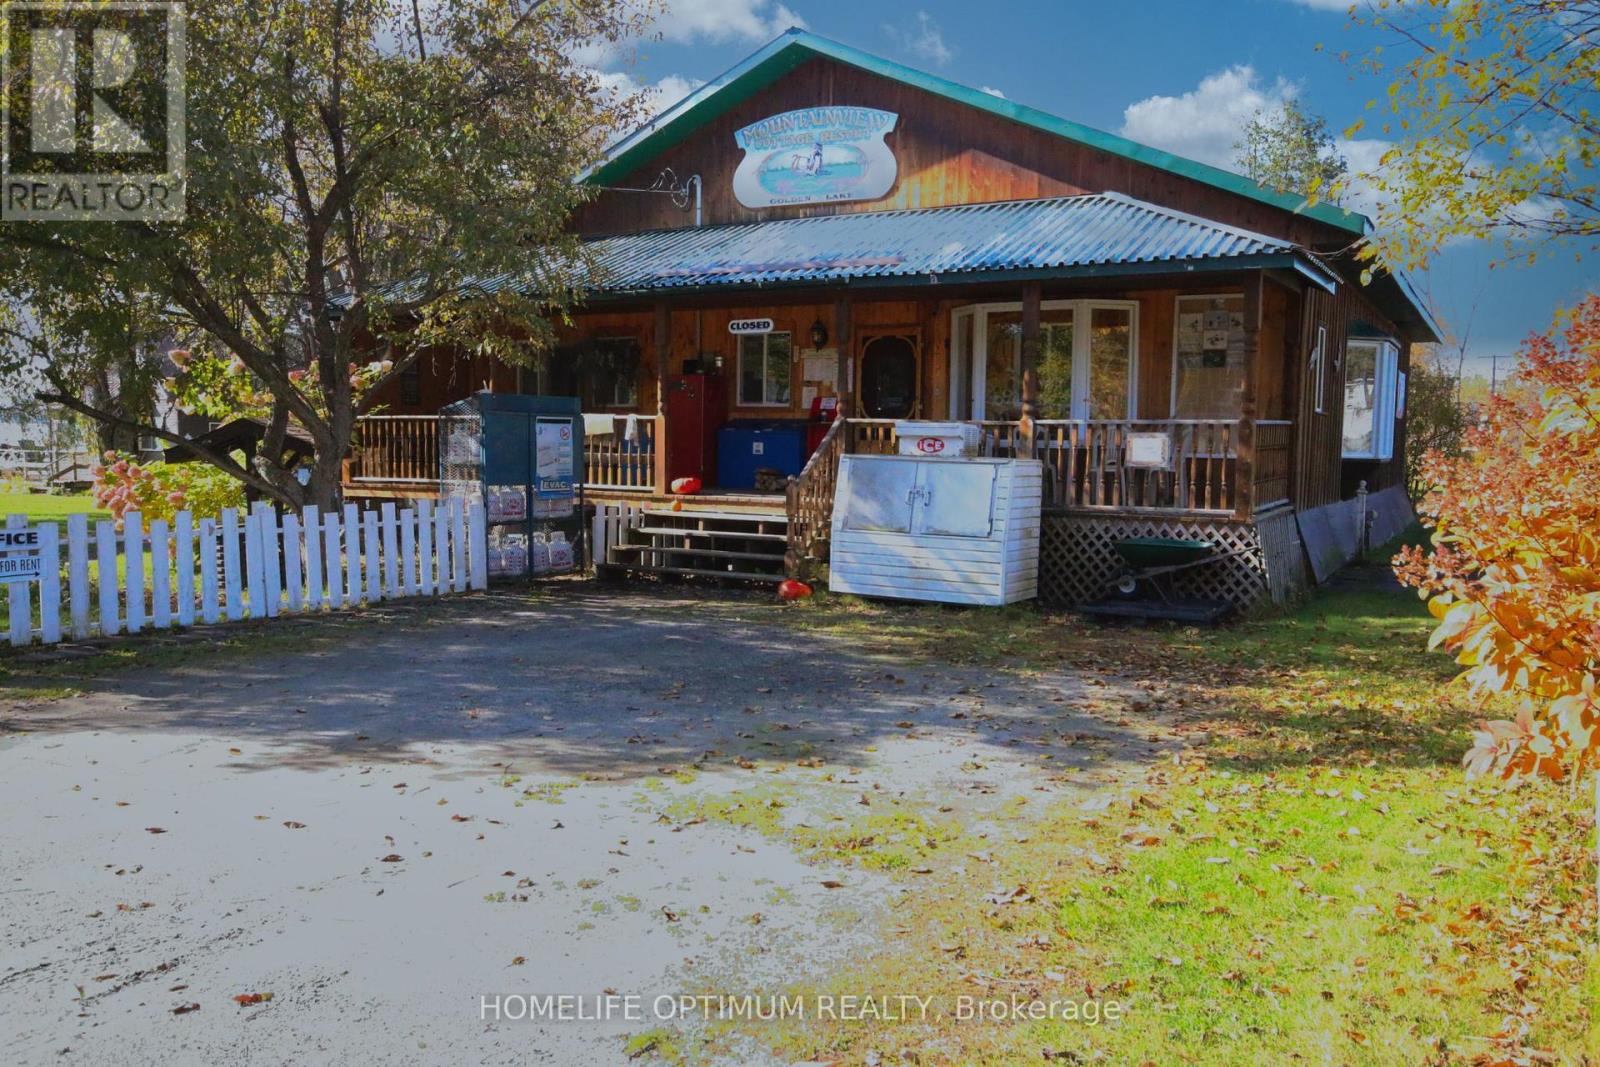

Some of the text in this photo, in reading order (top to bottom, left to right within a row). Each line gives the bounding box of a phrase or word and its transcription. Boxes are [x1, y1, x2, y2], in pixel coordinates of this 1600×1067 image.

[742, 107, 890, 147] MOUNTAINVIEW
[769, 193, 852, 205] GOLDEN LAKE
[730, 321, 771, 331] CLOSED
[0, 558, 41, 573] FOR RENT
